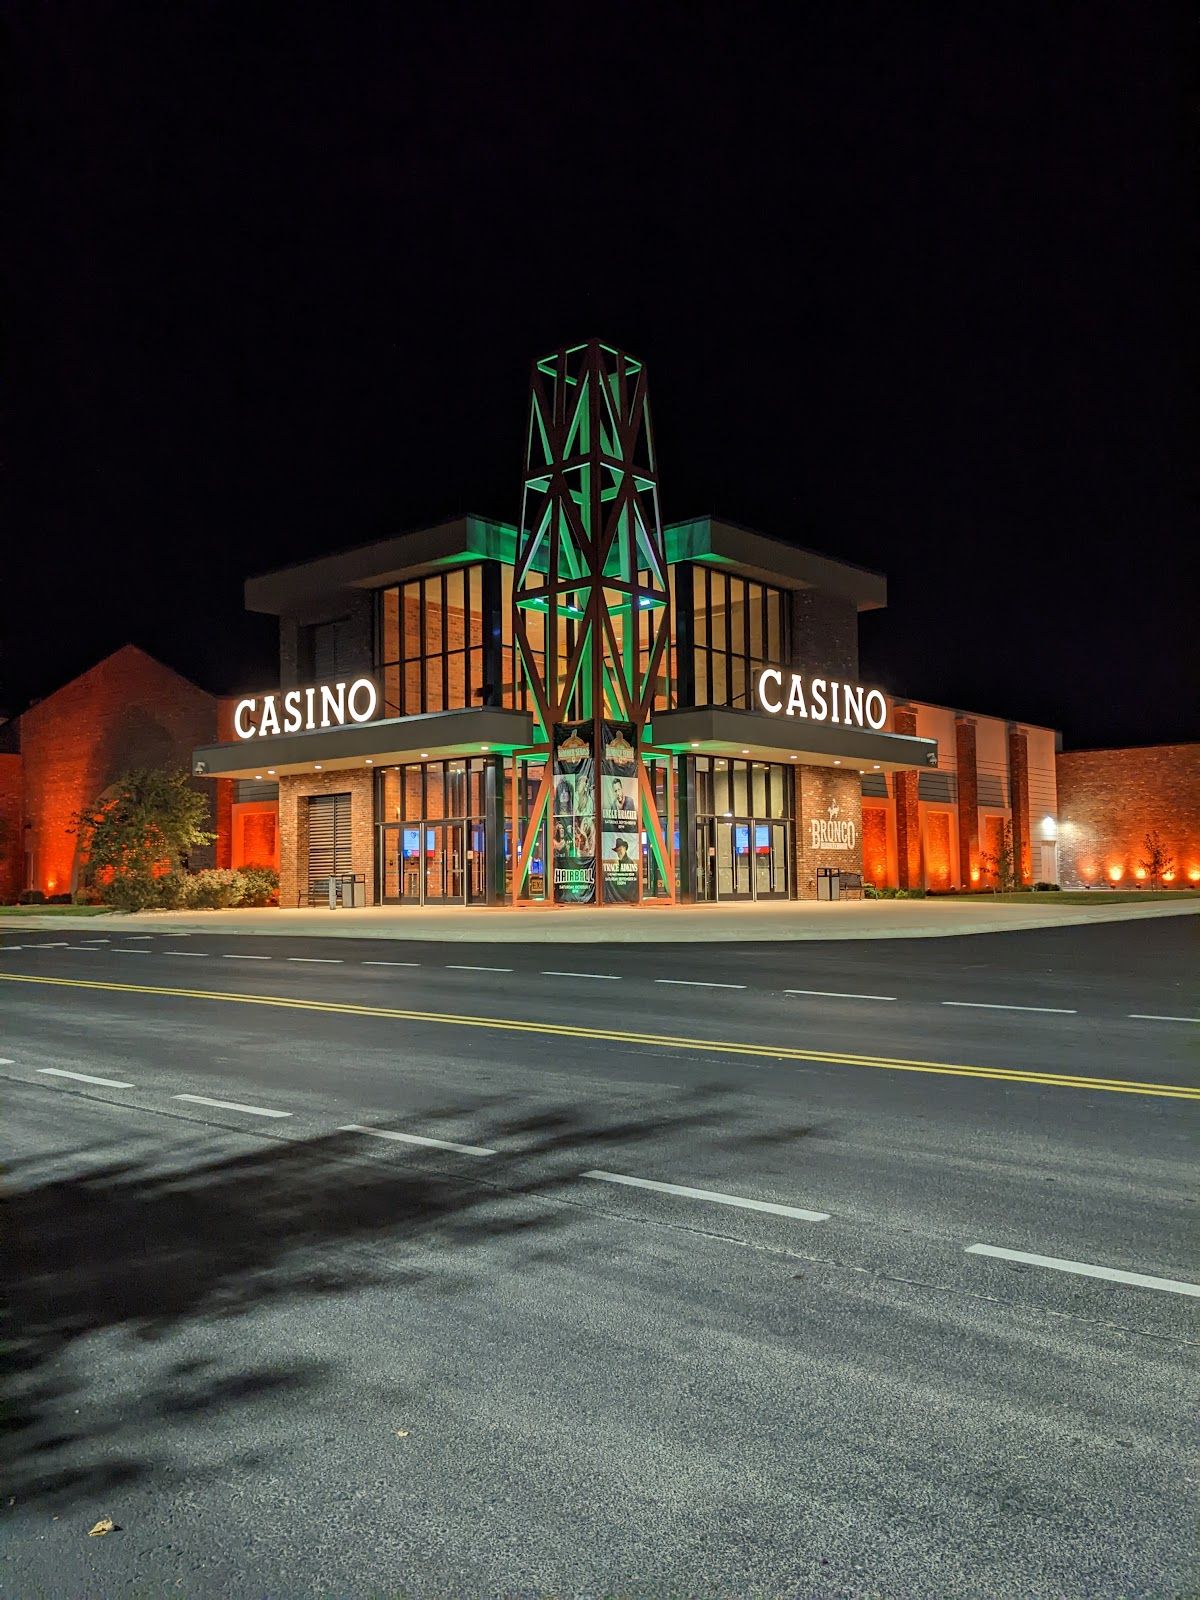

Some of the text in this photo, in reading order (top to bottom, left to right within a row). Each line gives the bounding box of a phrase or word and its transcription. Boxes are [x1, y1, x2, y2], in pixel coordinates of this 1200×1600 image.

[234, 678, 377, 739] CASINO
[758, 668, 887, 730] CASINO
[811, 819, 856, 850] BRONCO
[554, 868, 595, 884] HAIRBALL
